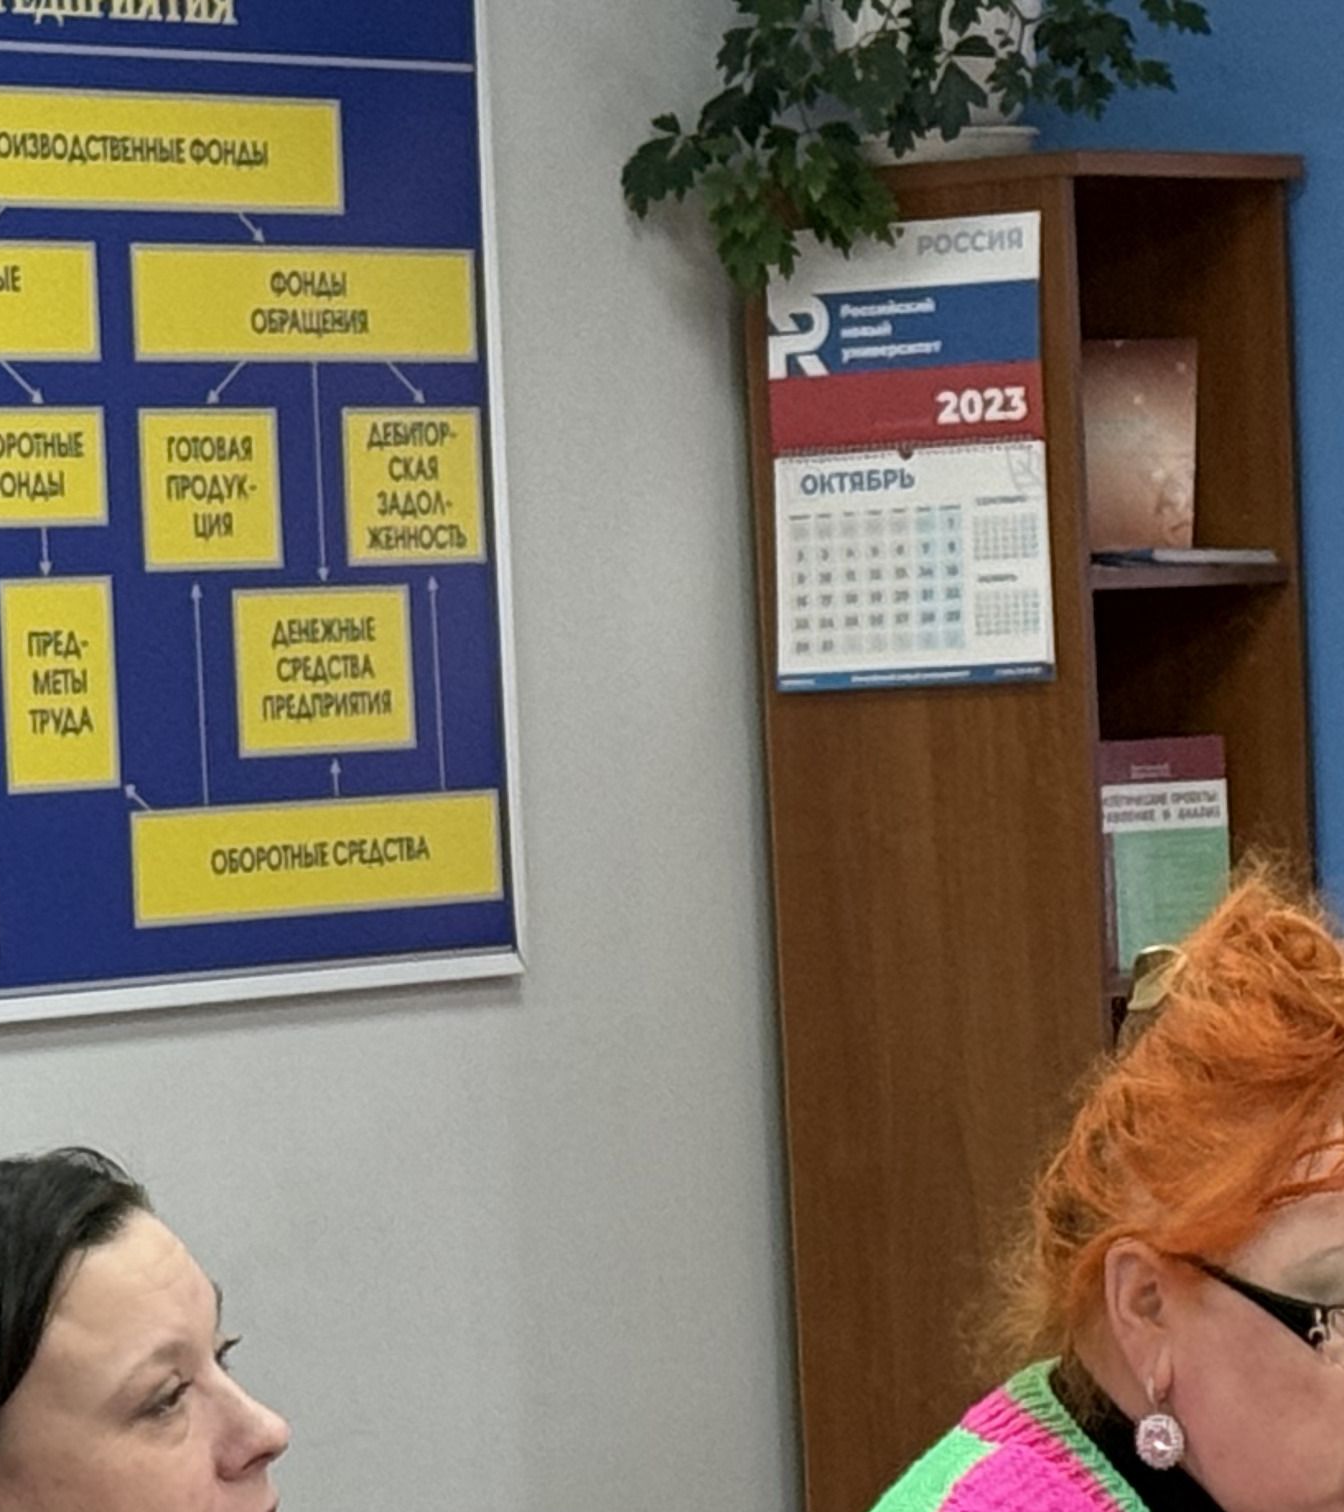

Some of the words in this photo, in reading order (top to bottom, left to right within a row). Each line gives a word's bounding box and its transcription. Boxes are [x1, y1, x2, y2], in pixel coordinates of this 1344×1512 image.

[190, 138, 269, 168] ФОНДЫ
[917, 227, 1024, 255] РОССИЯ
[271, 271, 347, 299] ФОНДЫ
[251, 308, 368, 337] ОБРАЩЕНИЯ
[936, 386, 1028, 425] 2023
[367, 421, 457, 449] ДЕБИТОР-
[167, 436, 253, 464] ГОТОВАЯ
[389, 455, 438, 481] СКАЯ
[800, 467, 915, 496] ОКТЯБРЬ
[167, 474, 257, 502] ПРОДУК-
[377, 490, 453, 517] ЗАДОЛ-
[194, 512, 233, 541] ЦИЯ
[367, 524, 467, 551] ЖЕННОСТЬ
[27, 631, 89, 660] ПРЕД-
[272, 616, 376, 650] ДЕНЕЖНЫЕ
[33, 669, 88, 696] МЕТЫ
[277, 654, 375, 684] СРЕДСТВА
[30, 707, 93, 737] ТРУДА
[263, 691, 392, 724] ПРЕДПРИЯТИЯ
[211, 843, 329, 877] ОБОРОТНЫЕ
[333, 837, 430, 868] СРЕДСТВА
